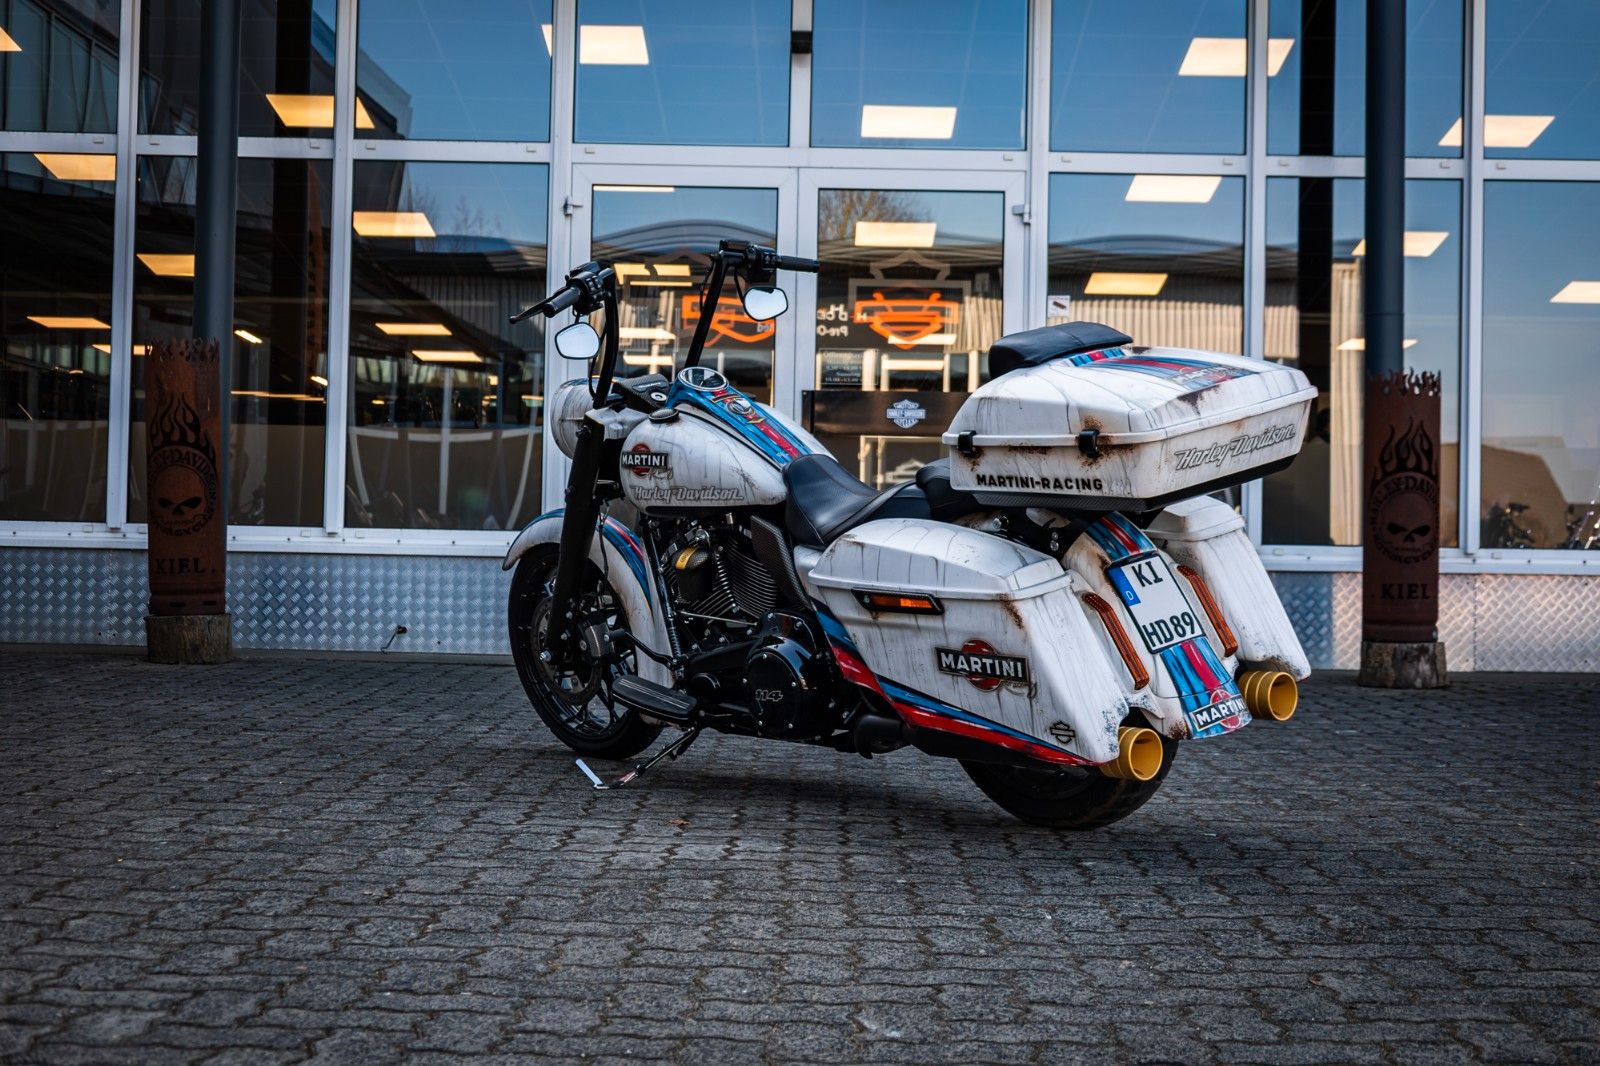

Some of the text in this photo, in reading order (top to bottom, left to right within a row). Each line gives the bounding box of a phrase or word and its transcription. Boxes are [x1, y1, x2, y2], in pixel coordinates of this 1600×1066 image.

[1174, 422, 1296, 471] Harley-Davidson
[622, 453, 666, 467] MARTINI
[976, 473, 1103, 492] MARTINI-RACING
[630, 485, 744, 504] Harley-Davidson
[155, 558, 206, 575] KIEL
[1131, 561, 1163, 587] KI
[1125, 590, 1134, 601] D
[1380, 583, 1431, 600] KIEL
[940, 652, 1023, 678] MARTINI
[755, 688, 784, 702] 114
